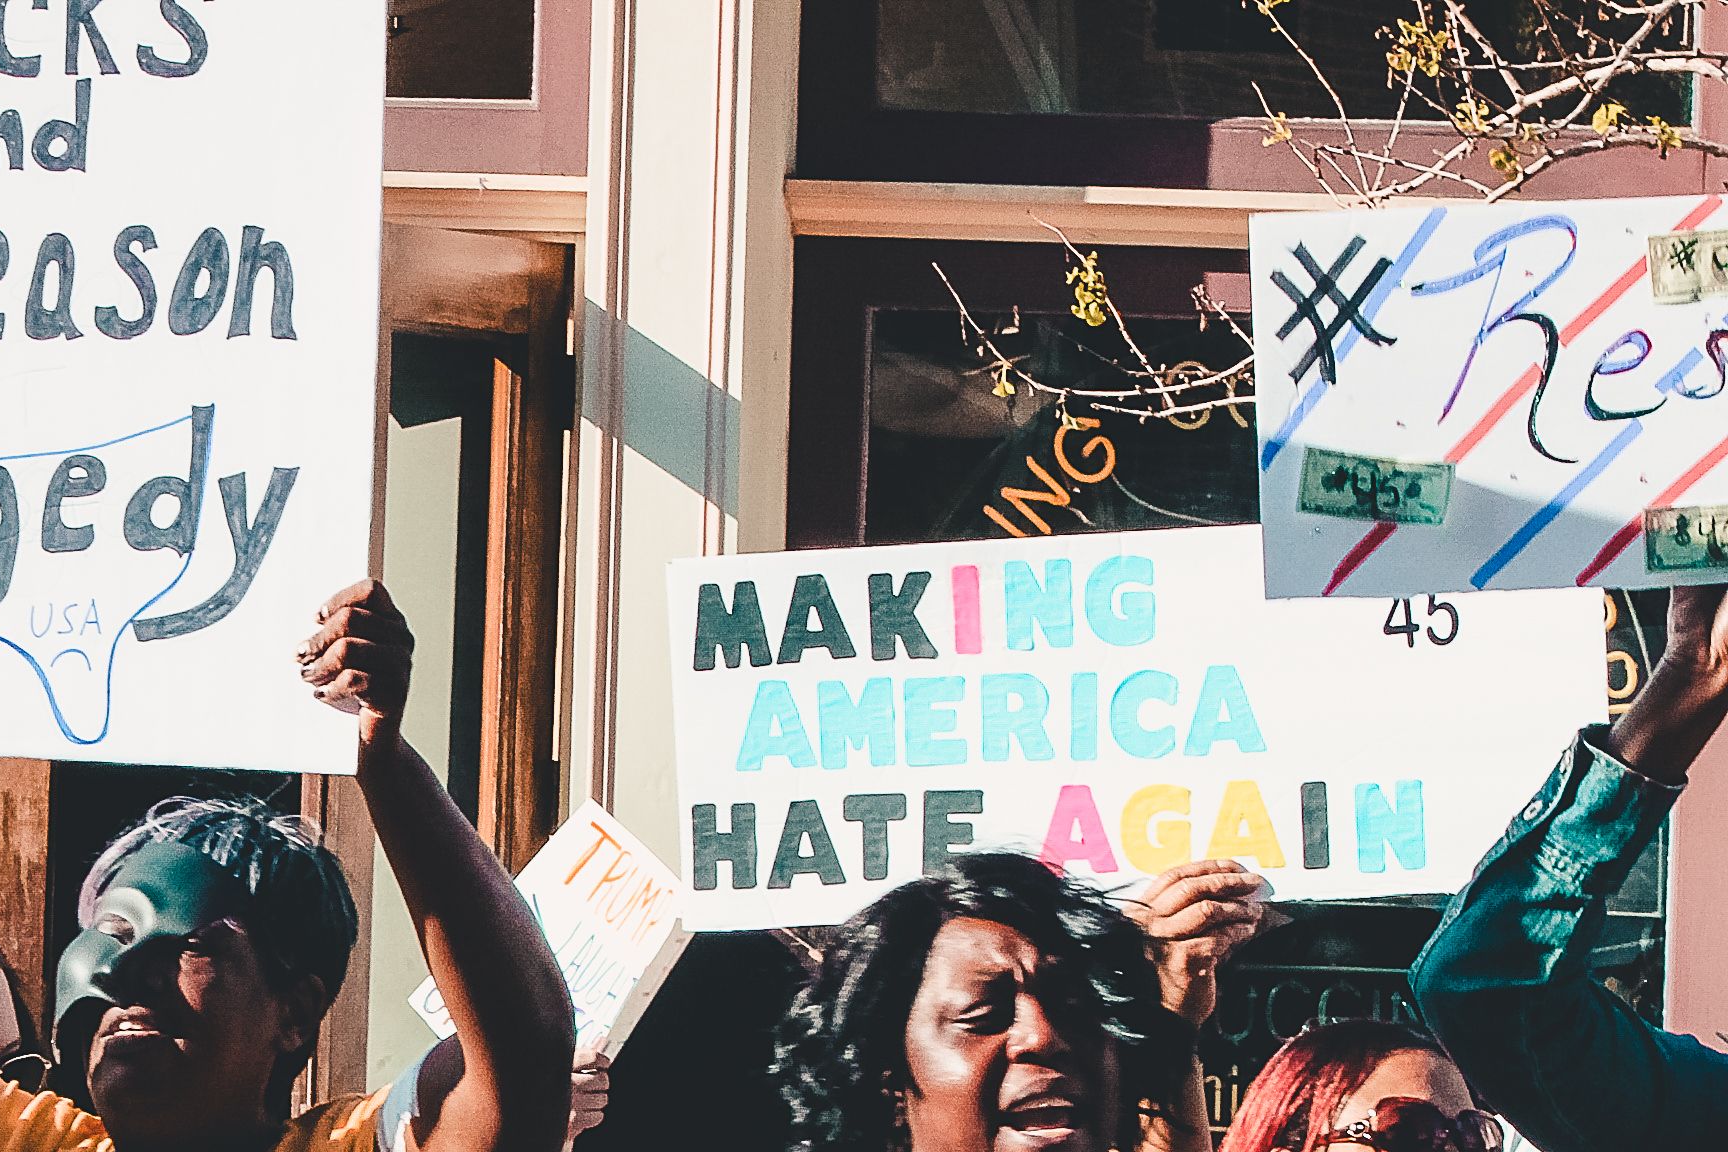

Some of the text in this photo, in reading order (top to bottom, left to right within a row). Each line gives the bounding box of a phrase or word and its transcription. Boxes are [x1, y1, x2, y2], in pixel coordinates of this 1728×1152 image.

[29, 598, 103, 639] USA
[693, 555, 1155, 672] MAKING
[736, 664, 1267, 772] AMERICA
[691, 778, 1428, 892] HATE AGAIN
